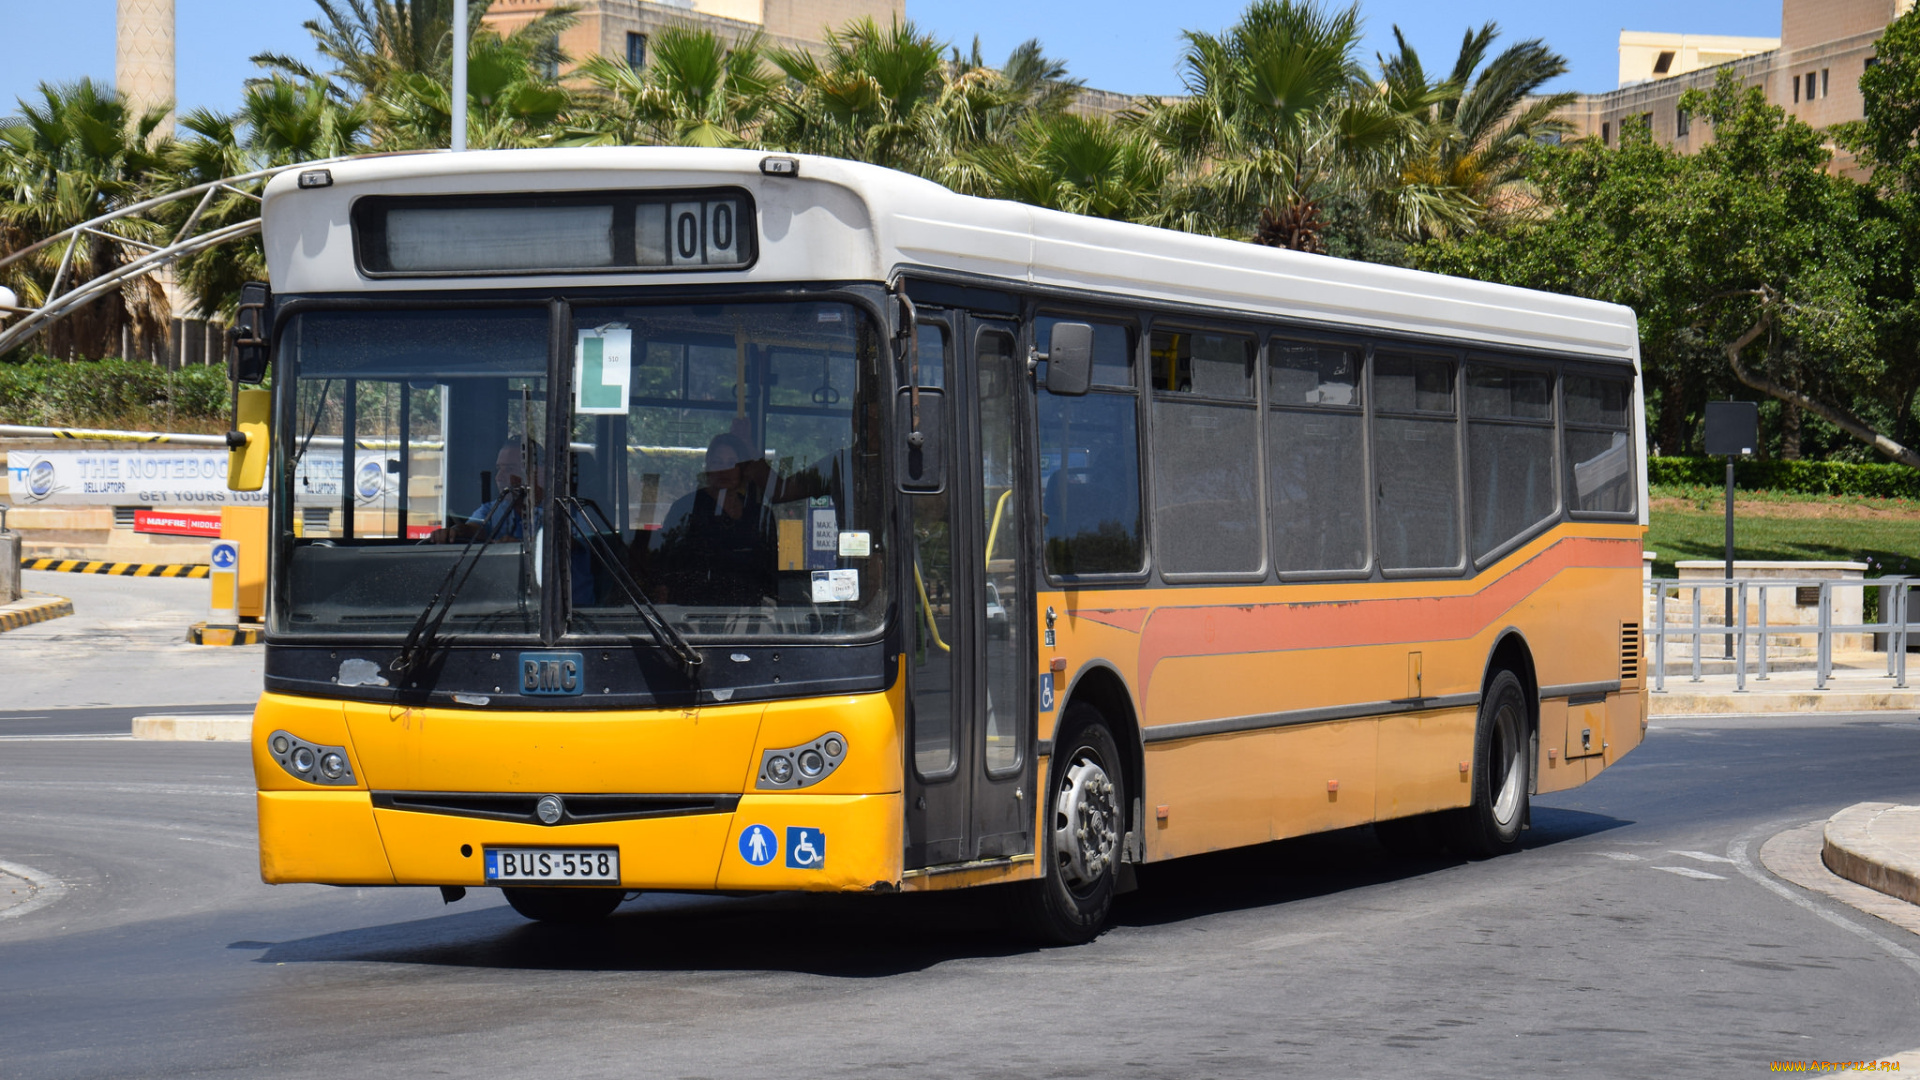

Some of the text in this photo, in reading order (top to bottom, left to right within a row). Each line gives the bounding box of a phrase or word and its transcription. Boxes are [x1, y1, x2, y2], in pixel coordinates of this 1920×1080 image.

[77, 458, 120, 479] THE
[127, 459, 229, 480] NOTEBOO
[84, 482, 126, 493] DELL LAPTOPS
[139, 491, 269, 502] GET YOURS TODA
[146, 517, 187, 528] MAPFRE
[524, 660, 577, 692] BMC
